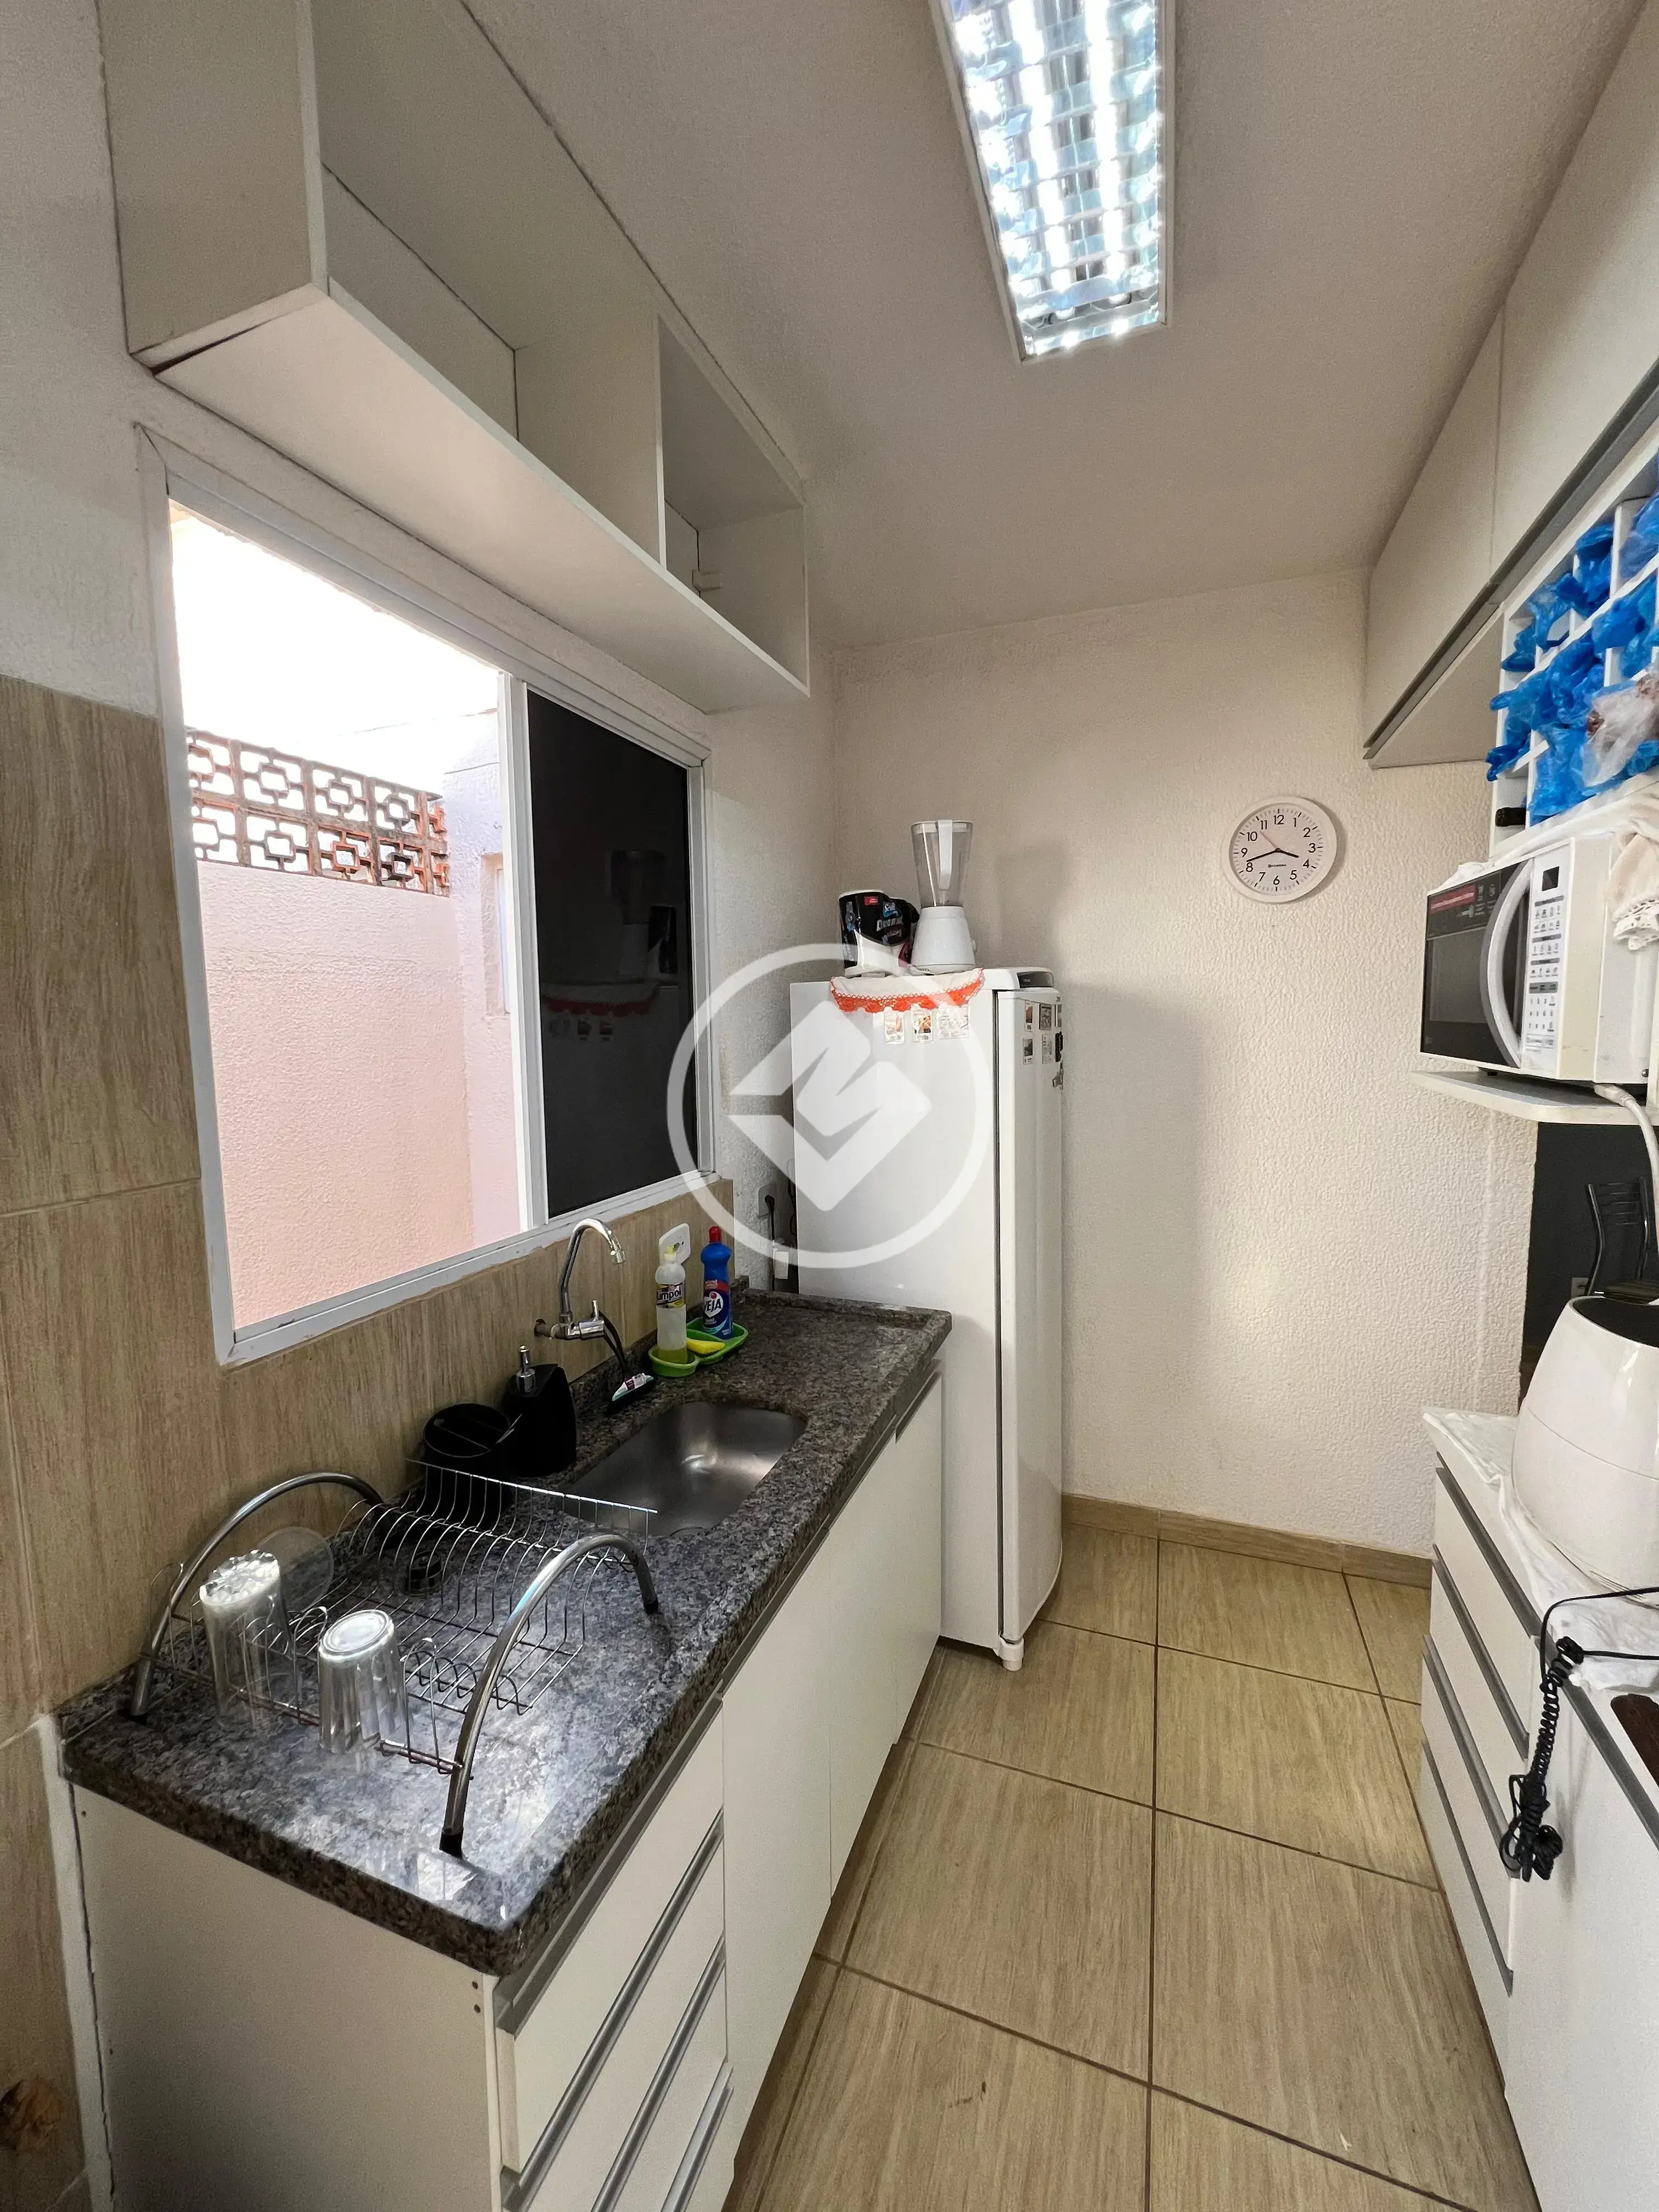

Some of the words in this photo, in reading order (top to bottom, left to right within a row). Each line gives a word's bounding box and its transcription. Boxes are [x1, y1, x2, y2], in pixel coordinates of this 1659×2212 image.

[1260, 820, 1267, 830] 11
[1273, 815, 1284, 825] 12
[1293, 817, 1297, 827] 1
[1246, 831, 1257, 842] 10
[1303, 828, 1310, 838] 2
[1241, 848, 1248, 857] 9
[1308, 843, 1316, 853] 3
[1245, 862, 1253, 872] 8
[1302, 859, 1310, 868] 4
[1259, 872, 1266, 882] 7
[1290, 870, 1297, 880] 5
[1273, 876, 1280, 885] 6
[704, 1299, 721, 1312] VEJA
